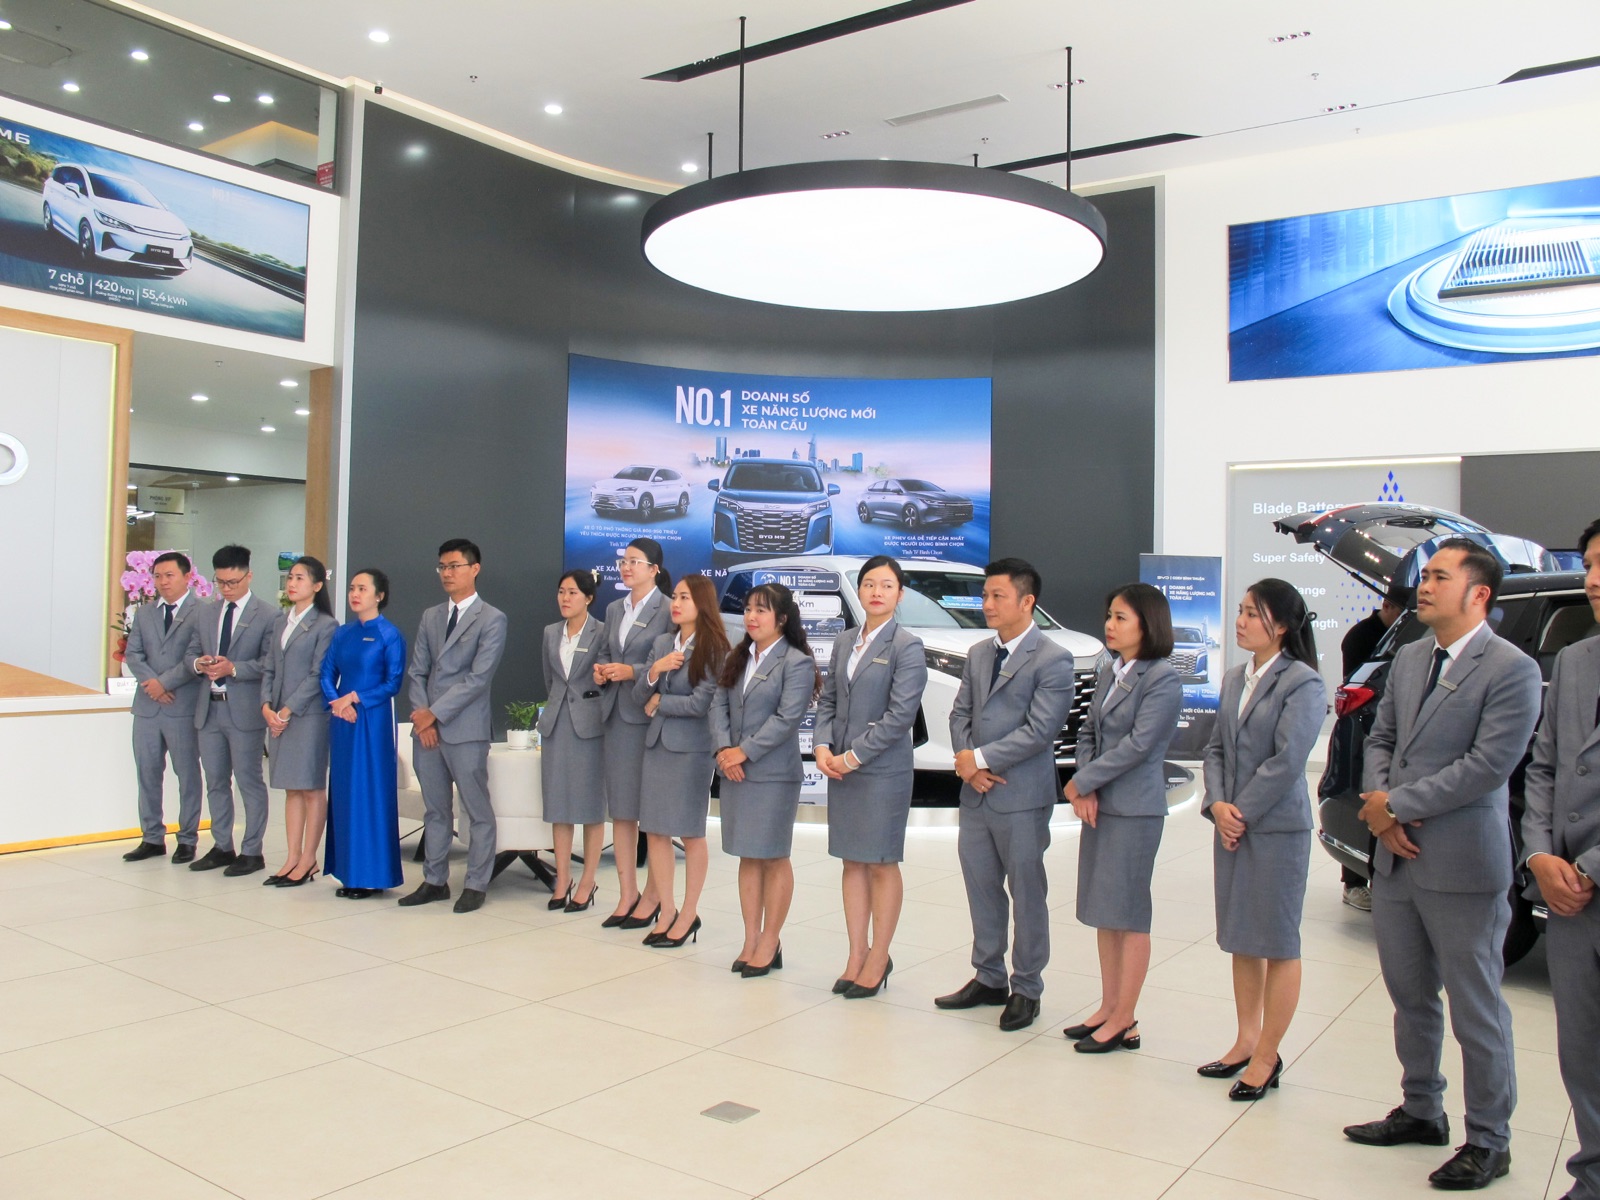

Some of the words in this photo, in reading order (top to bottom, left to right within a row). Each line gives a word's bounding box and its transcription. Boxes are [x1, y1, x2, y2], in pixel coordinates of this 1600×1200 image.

[0, 128, 30, 145] M6
[48, 269, 57, 280] 7
[60, 272, 85, 286] chỗ
[95, 279, 119, 293] 420
[120, 285, 135, 296] km
[142, 288, 166, 302] 55,4
[167, 295, 188, 307] kWh
[741, 390, 789, 403] DOANH
[792, 391, 810, 404] SỐ
[675, 385, 732, 428] NO.1
[741, 404, 758, 416] XE
[761, 404, 799, 417] NĂNG
[802, 407, 847, 421] LƯỢNG
[851, 407, 876, 419] MỚI
[741, 418, 777, 430] TOÀN
[780, 418, 807, 432] CẦU
[1253, 502, 1293, 515] Blade
[1297, 501, 1350, 514] Batter
[1253, 553, 1287, 565] Super
[1289, 552, 1326, 564] Safety
[701, 569, 712, 577] XE
[715, 568, 728, 577] NĂ
[779, 575, 796, 587] NO.1
[1294, 586, 1327, 598] ange
